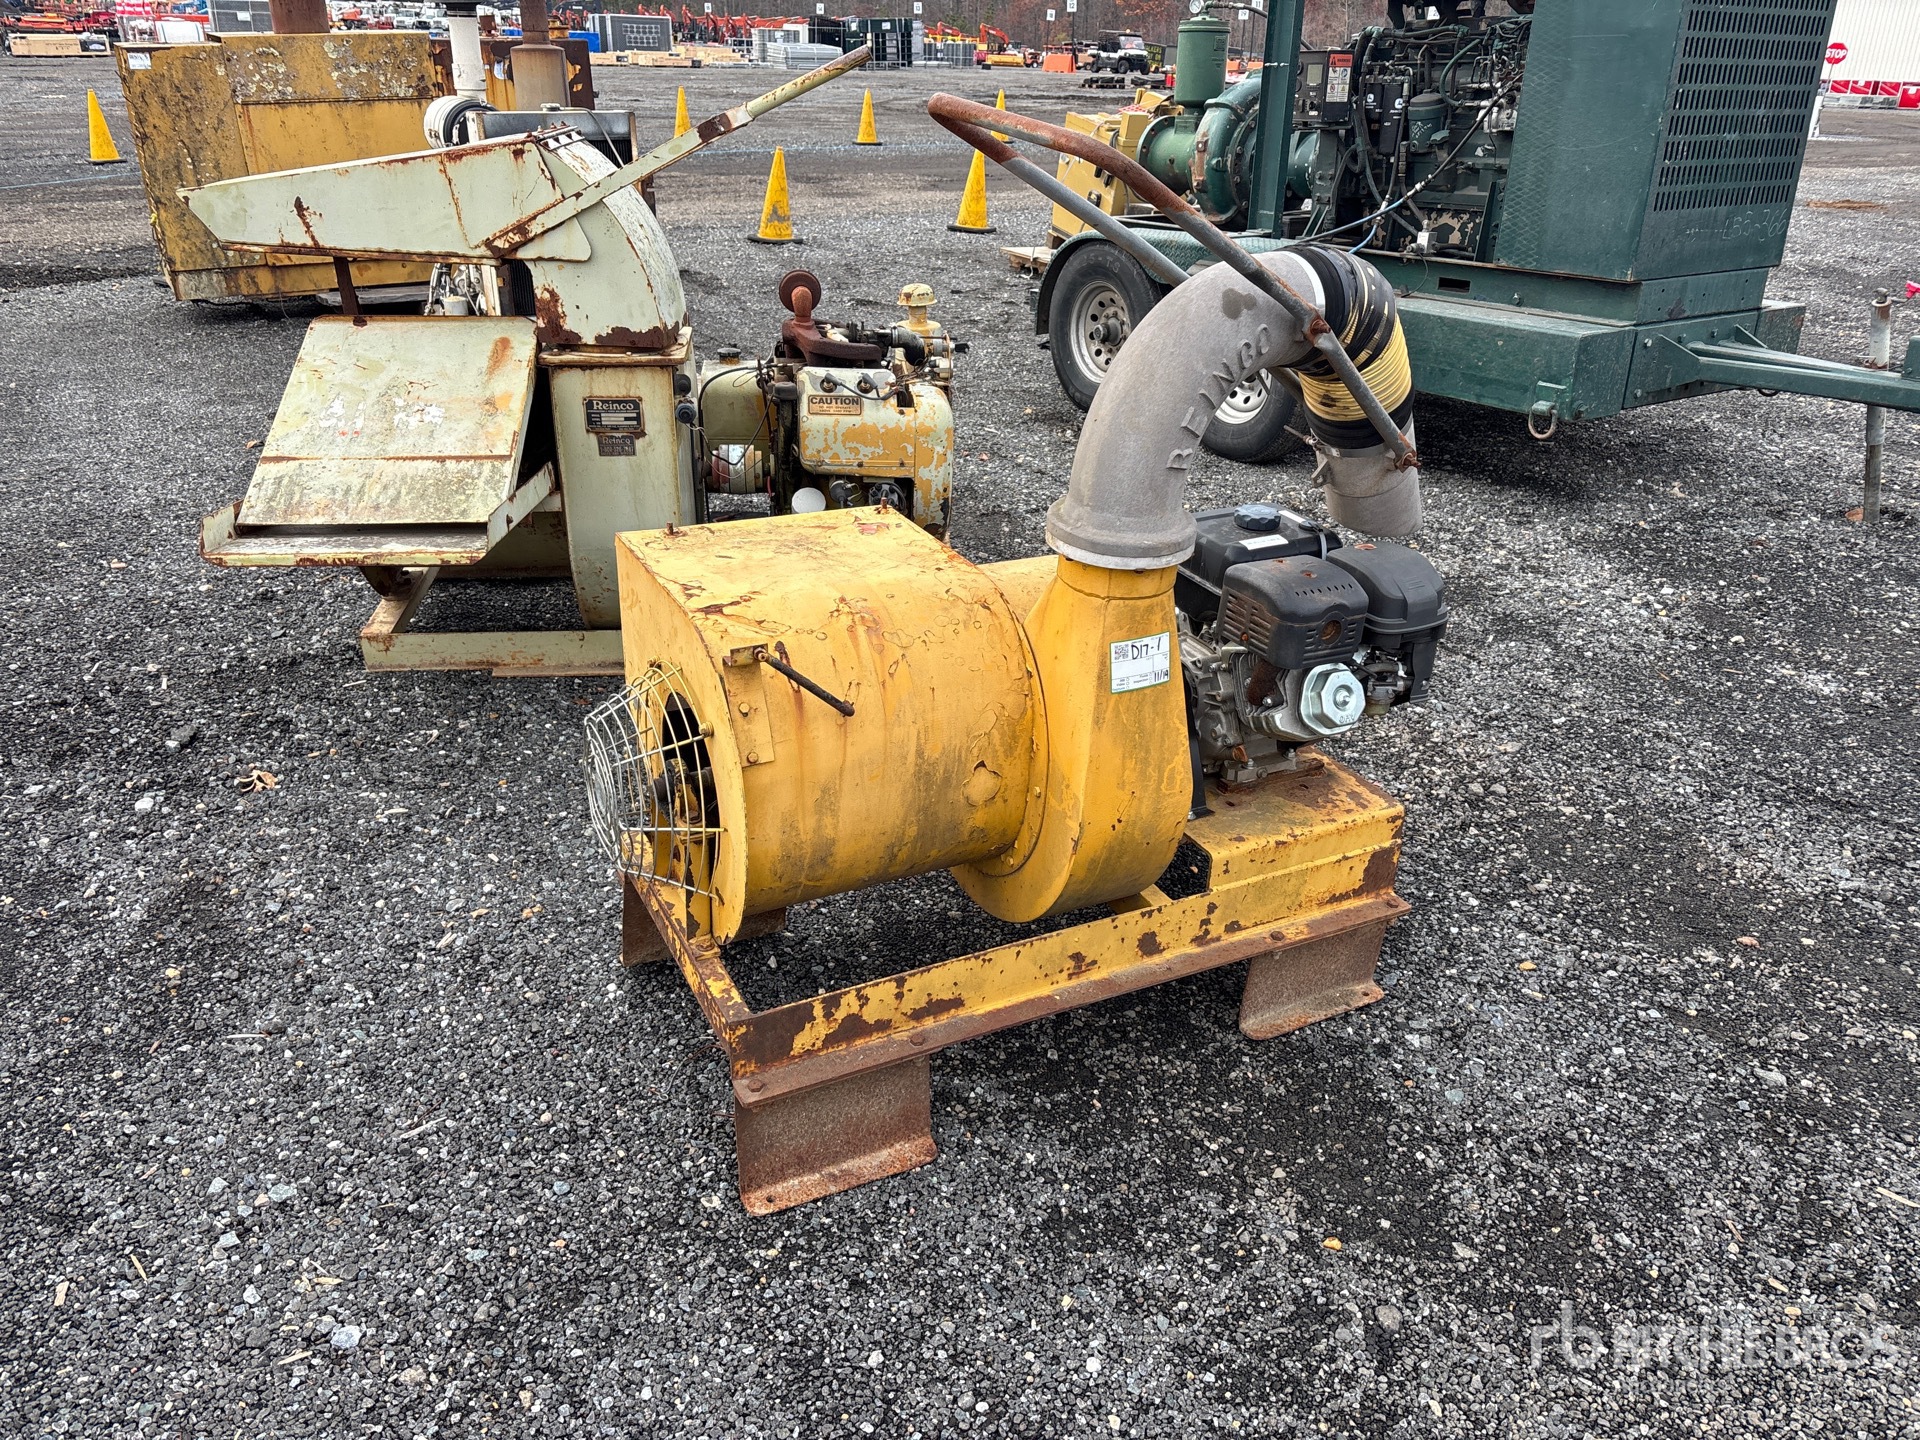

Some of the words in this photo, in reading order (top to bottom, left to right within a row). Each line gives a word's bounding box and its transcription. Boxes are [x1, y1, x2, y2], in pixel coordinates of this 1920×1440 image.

[1825, 48, 1847, 59] STOP
[592, 400, 634, 410] Reinco
[810, 396, 860, 406] CAUTION
[602, 436, 631, 446] Reinco
